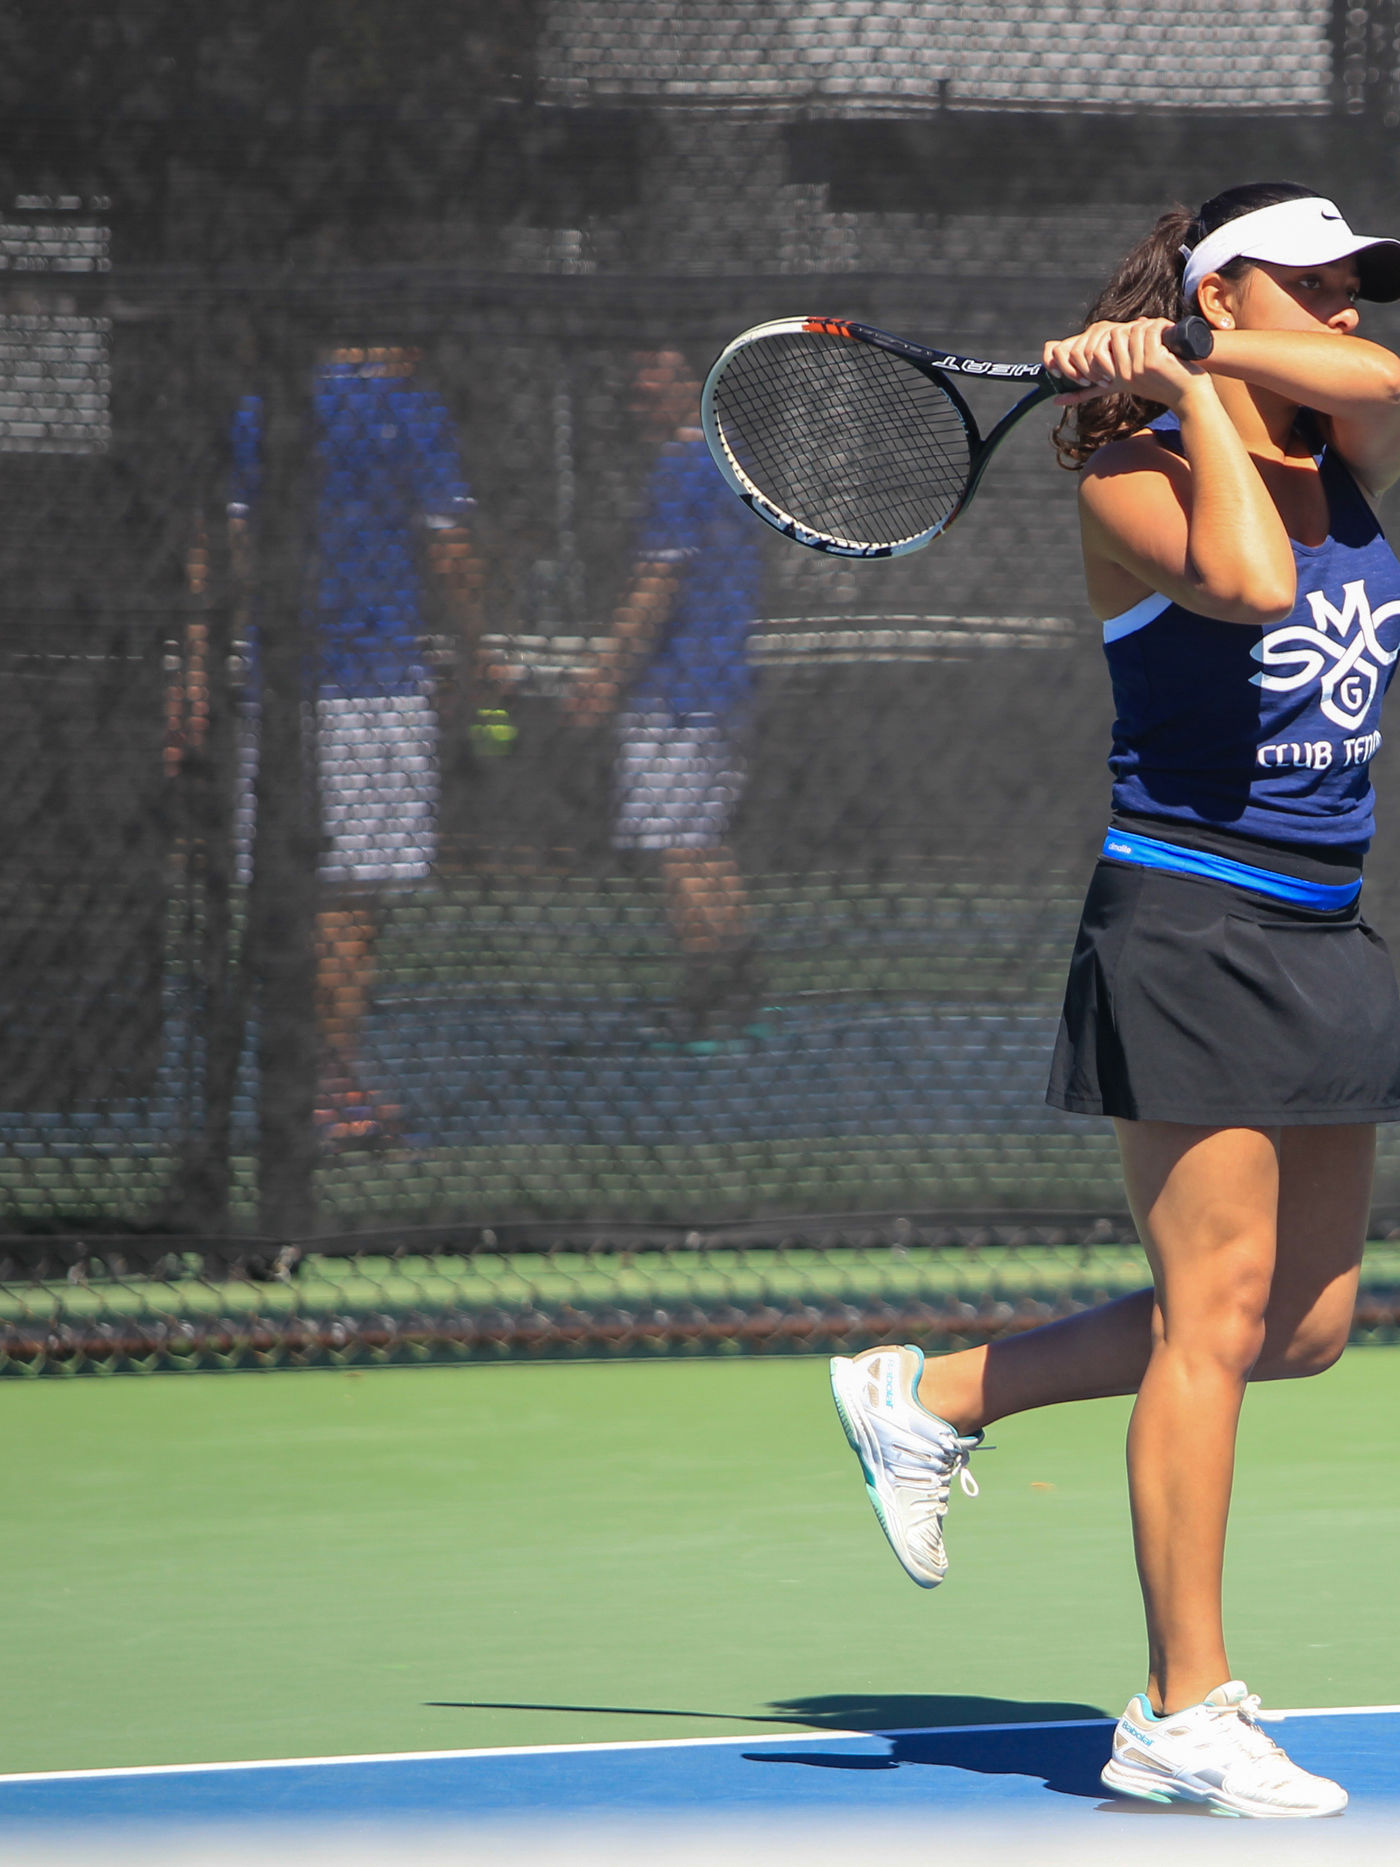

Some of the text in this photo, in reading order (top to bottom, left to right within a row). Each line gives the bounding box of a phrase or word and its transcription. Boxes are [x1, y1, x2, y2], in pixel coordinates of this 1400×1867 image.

[931, 356, 1042, 377] HEAT
[1340, 676, 1363, 710] G
[1257, 741, 1333, 770] CLUB
[1121, 1720, 1154, 1747] Babolat
